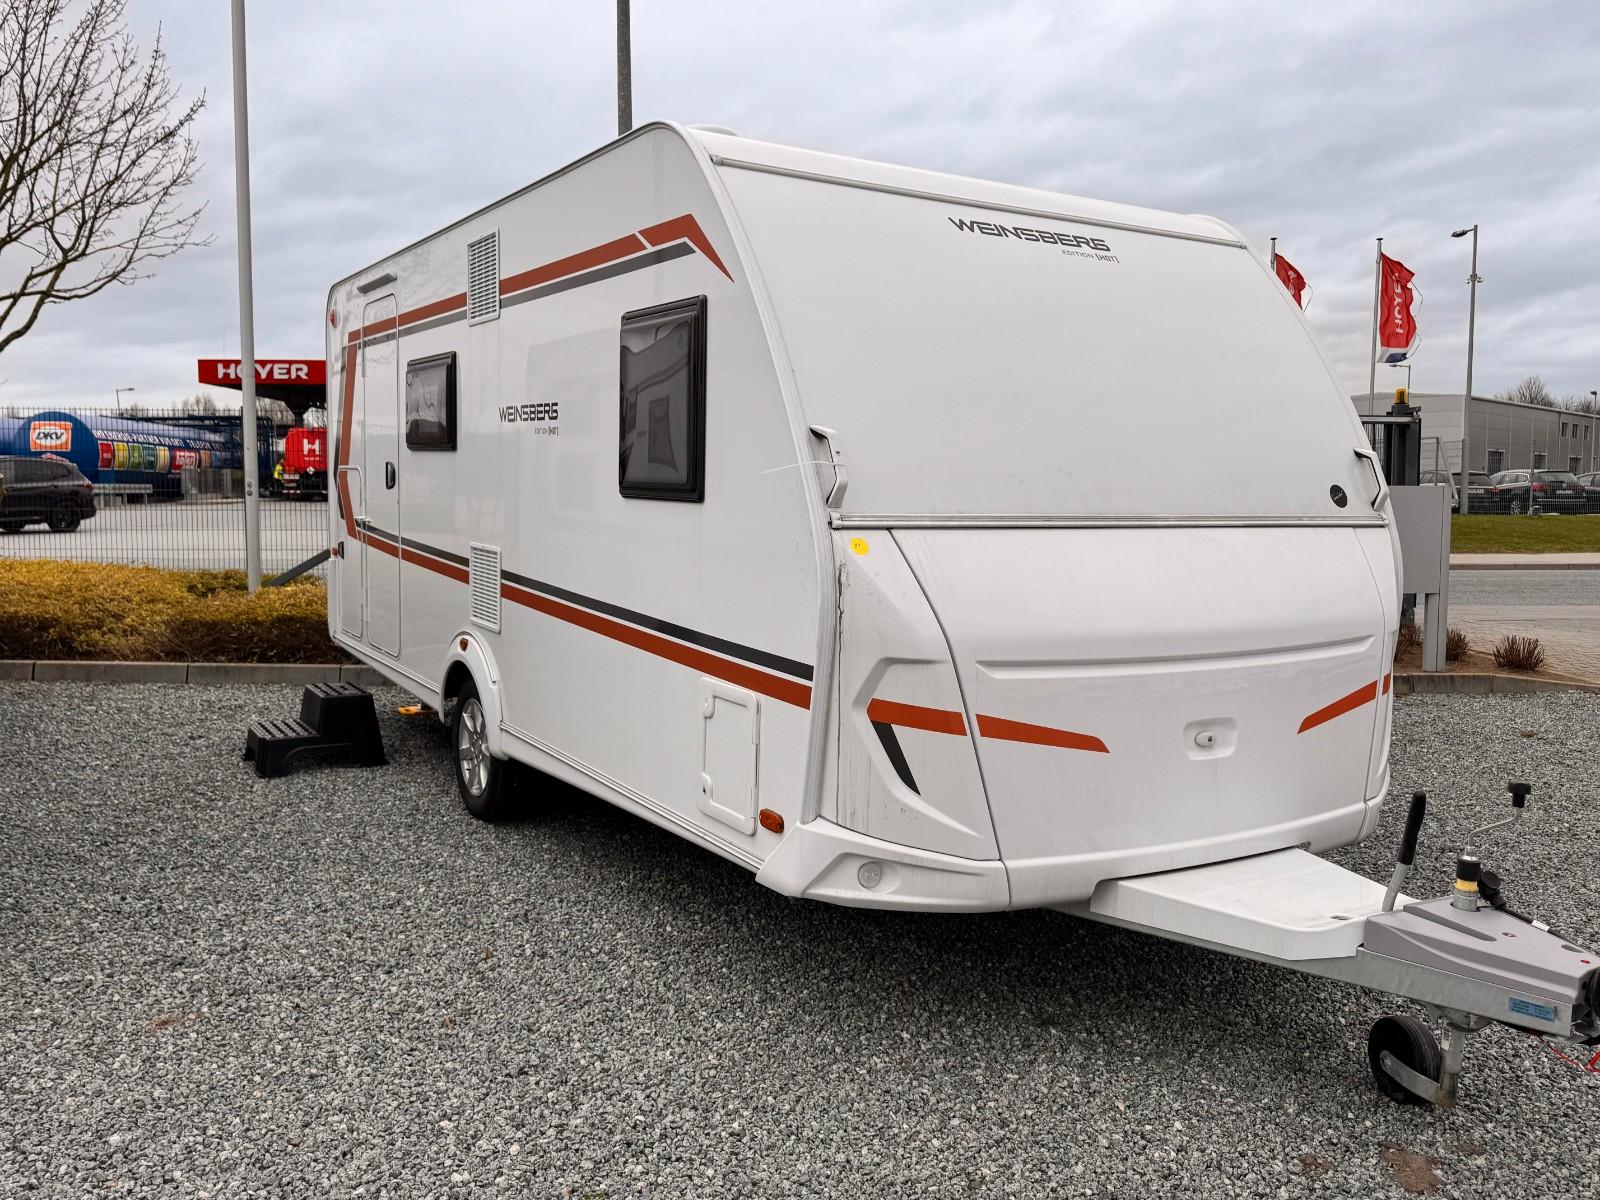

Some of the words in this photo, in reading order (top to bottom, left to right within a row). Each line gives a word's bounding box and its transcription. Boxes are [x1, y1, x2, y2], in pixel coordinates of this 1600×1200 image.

[948, 217, 1111, 252] WEINSBERG
[1061, 249, 1095, 259] EDITION
[217, 363, 309, 379] HYER
[499, 402, 559, 423] WEINSBERG
[36, 431, 67, 440] DKV
[303, 438, 320, 455] H
